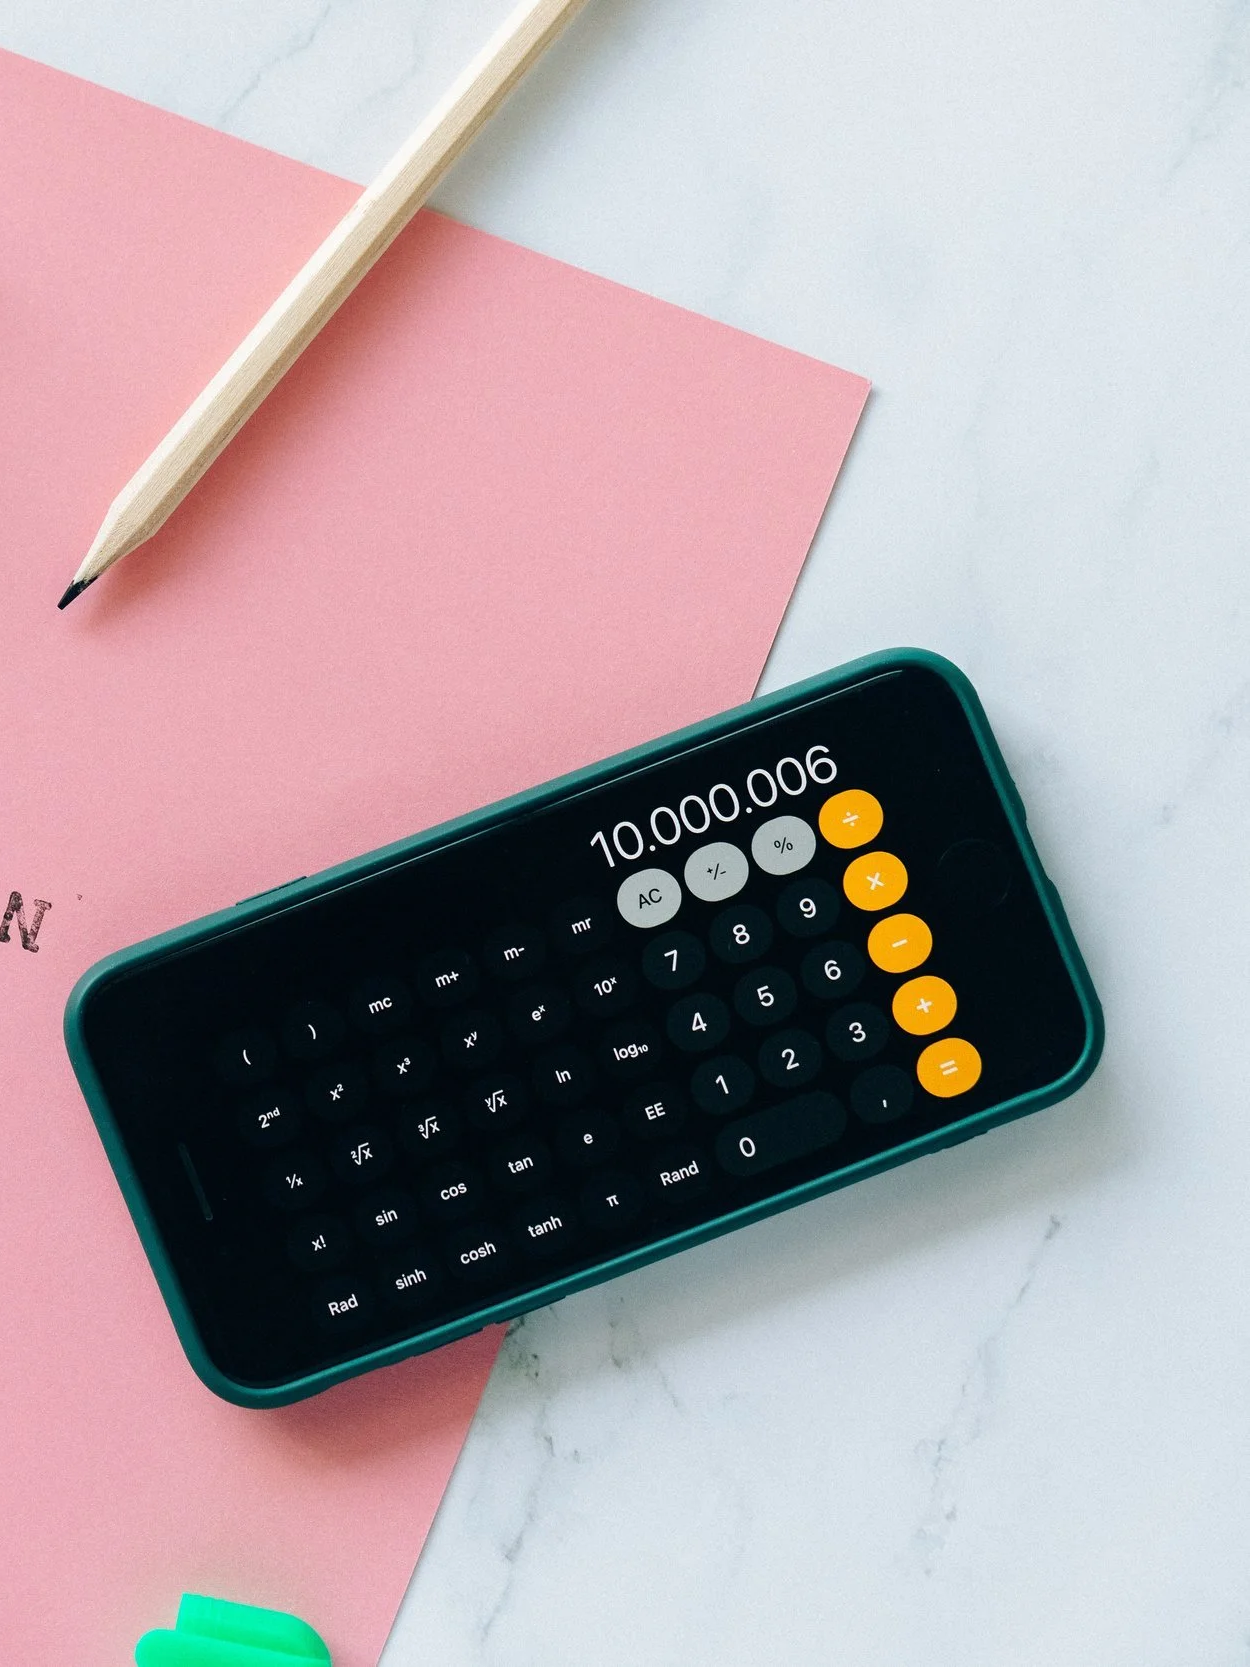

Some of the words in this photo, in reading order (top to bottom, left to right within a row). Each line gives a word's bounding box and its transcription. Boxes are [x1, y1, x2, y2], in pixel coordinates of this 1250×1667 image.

[590, 745, 838, 868] 10.000.006
[368, 996, 393, 1014] mc
[434, 970, 460, 988] m+
[503, 944, 526, 961] m-
[570, 917, 592, 935] mr
[637, 888, 662, 909] AC
[773, 836, 793, 854] %
[663, 949, 679, 972] 7
[732, 923, 751, 945] 8
[799, 897, 817, 919] 9
[555, 1069, 572, 1084] ln
[690, 1011, 708, 1034] 4
[756, 985, 775, 1007] 5
[824, 959, 842, 981] 6
[311, 1234, 327, 1252] x!
[375, 1209, 398, 1227] sin
[440, 1182, 468, 1201] cos
[507, 1155, 534, 1175] tan
[583, 1133, 594, 1145] e
[644, 1102, 666, 1121] EE
[715, 1074, 729, 1095] 1
[781, 1048, 800, 1071] 2
[848, 1021, 867, 1043] 3
[327, 1293, 359, 1316] Rad
[395, 1267, 428, 1290] sinh
[460, 1240, 497, 1266] cosh
[527, 1214, 563, 1239] tanh
[659, 1160, 700, 1187] Rand
[738, 1136, 757, 1158] 0
